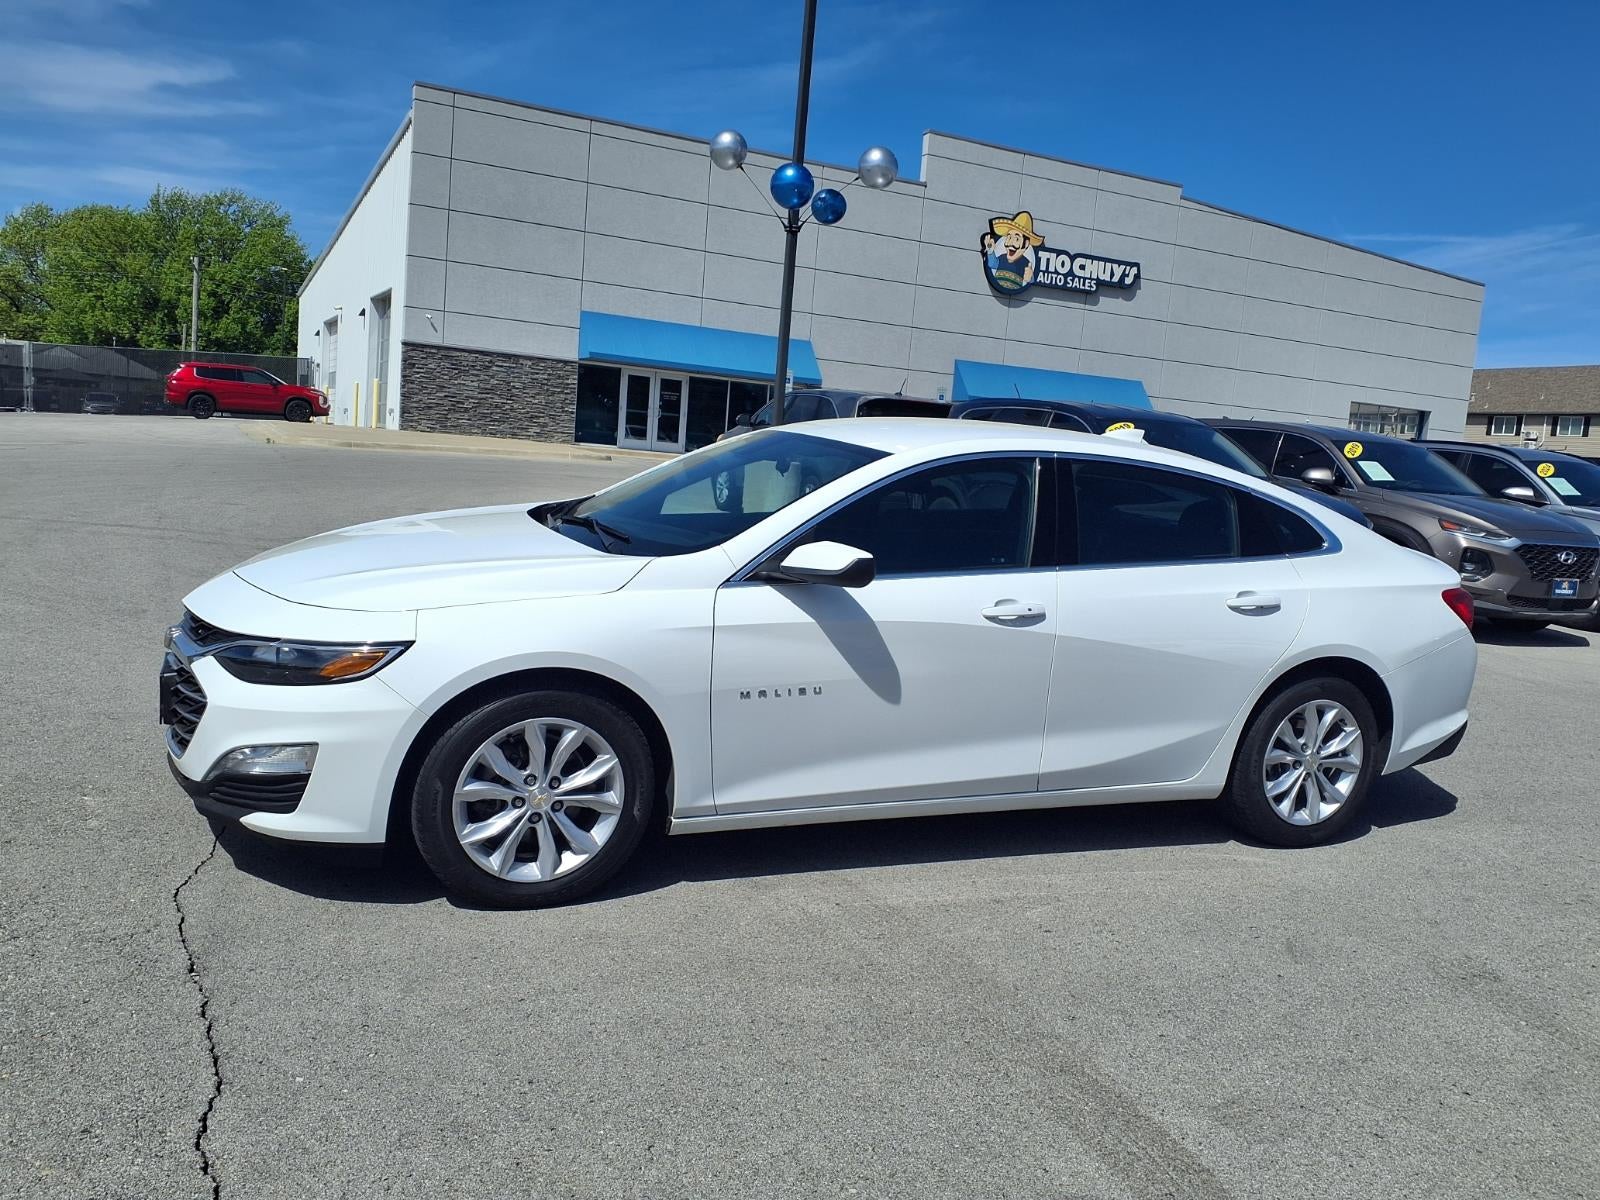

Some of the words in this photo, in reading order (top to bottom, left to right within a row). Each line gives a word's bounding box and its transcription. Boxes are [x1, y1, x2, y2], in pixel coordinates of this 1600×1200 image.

[1038, 251, 1071, 274] TIO
[1072, 257, 1138, 285] CHUY'S
[1036, 272, 1065, 286] AUTO
[1066, 276, 1097, 291] SALES
[740, 686, 822, 700] MALIBU
